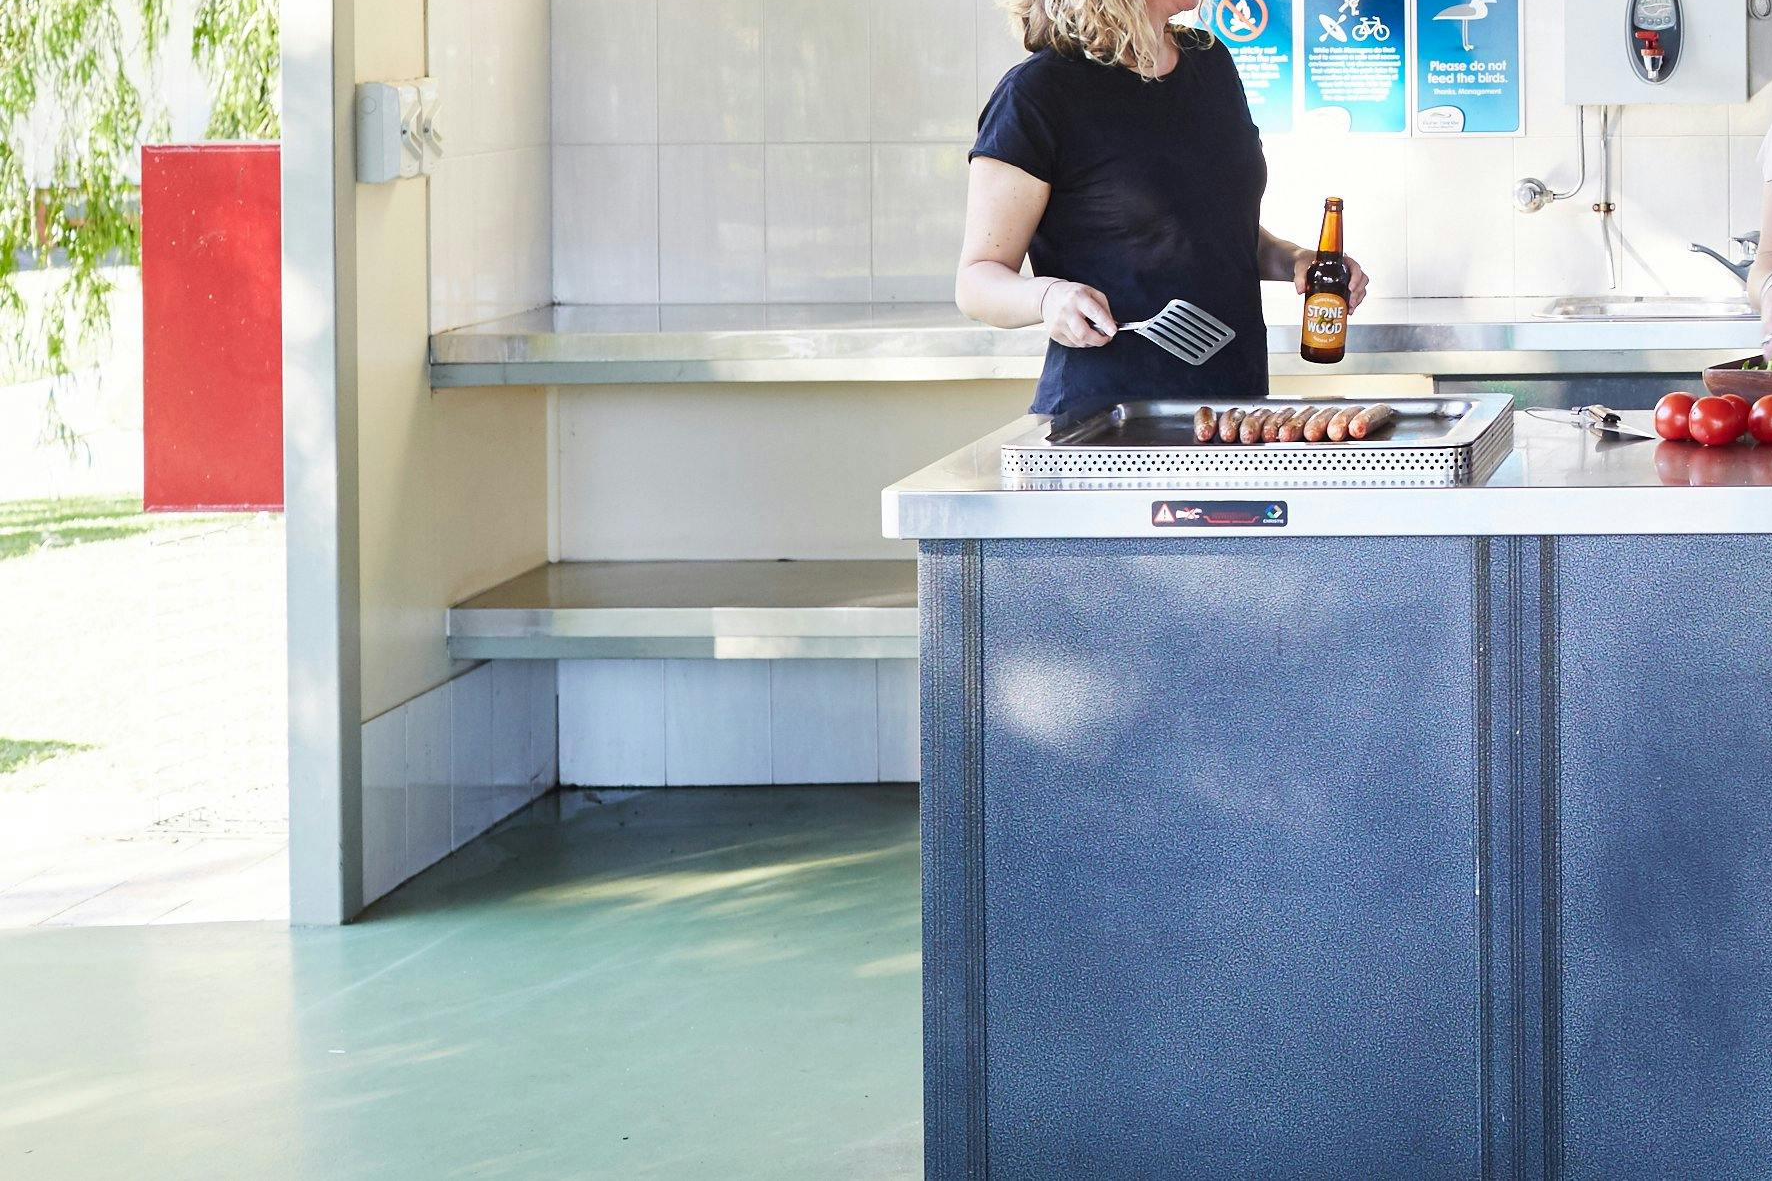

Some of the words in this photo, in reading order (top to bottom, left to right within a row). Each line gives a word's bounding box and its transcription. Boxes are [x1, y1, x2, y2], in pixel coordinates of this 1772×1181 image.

[1429, 60, 1467, 71] Please
[1469, 60, 1486, 71] do
[1488, 60, 1507, 71] not
[1427, 72, 1454, 83] feed
[1456, 72, 1475, 83] the
[1477, 72, 1508, 83] birds.
[1307, 305, 1344, 319] STONE
[1307, 319, 1342, 334] WOOD
